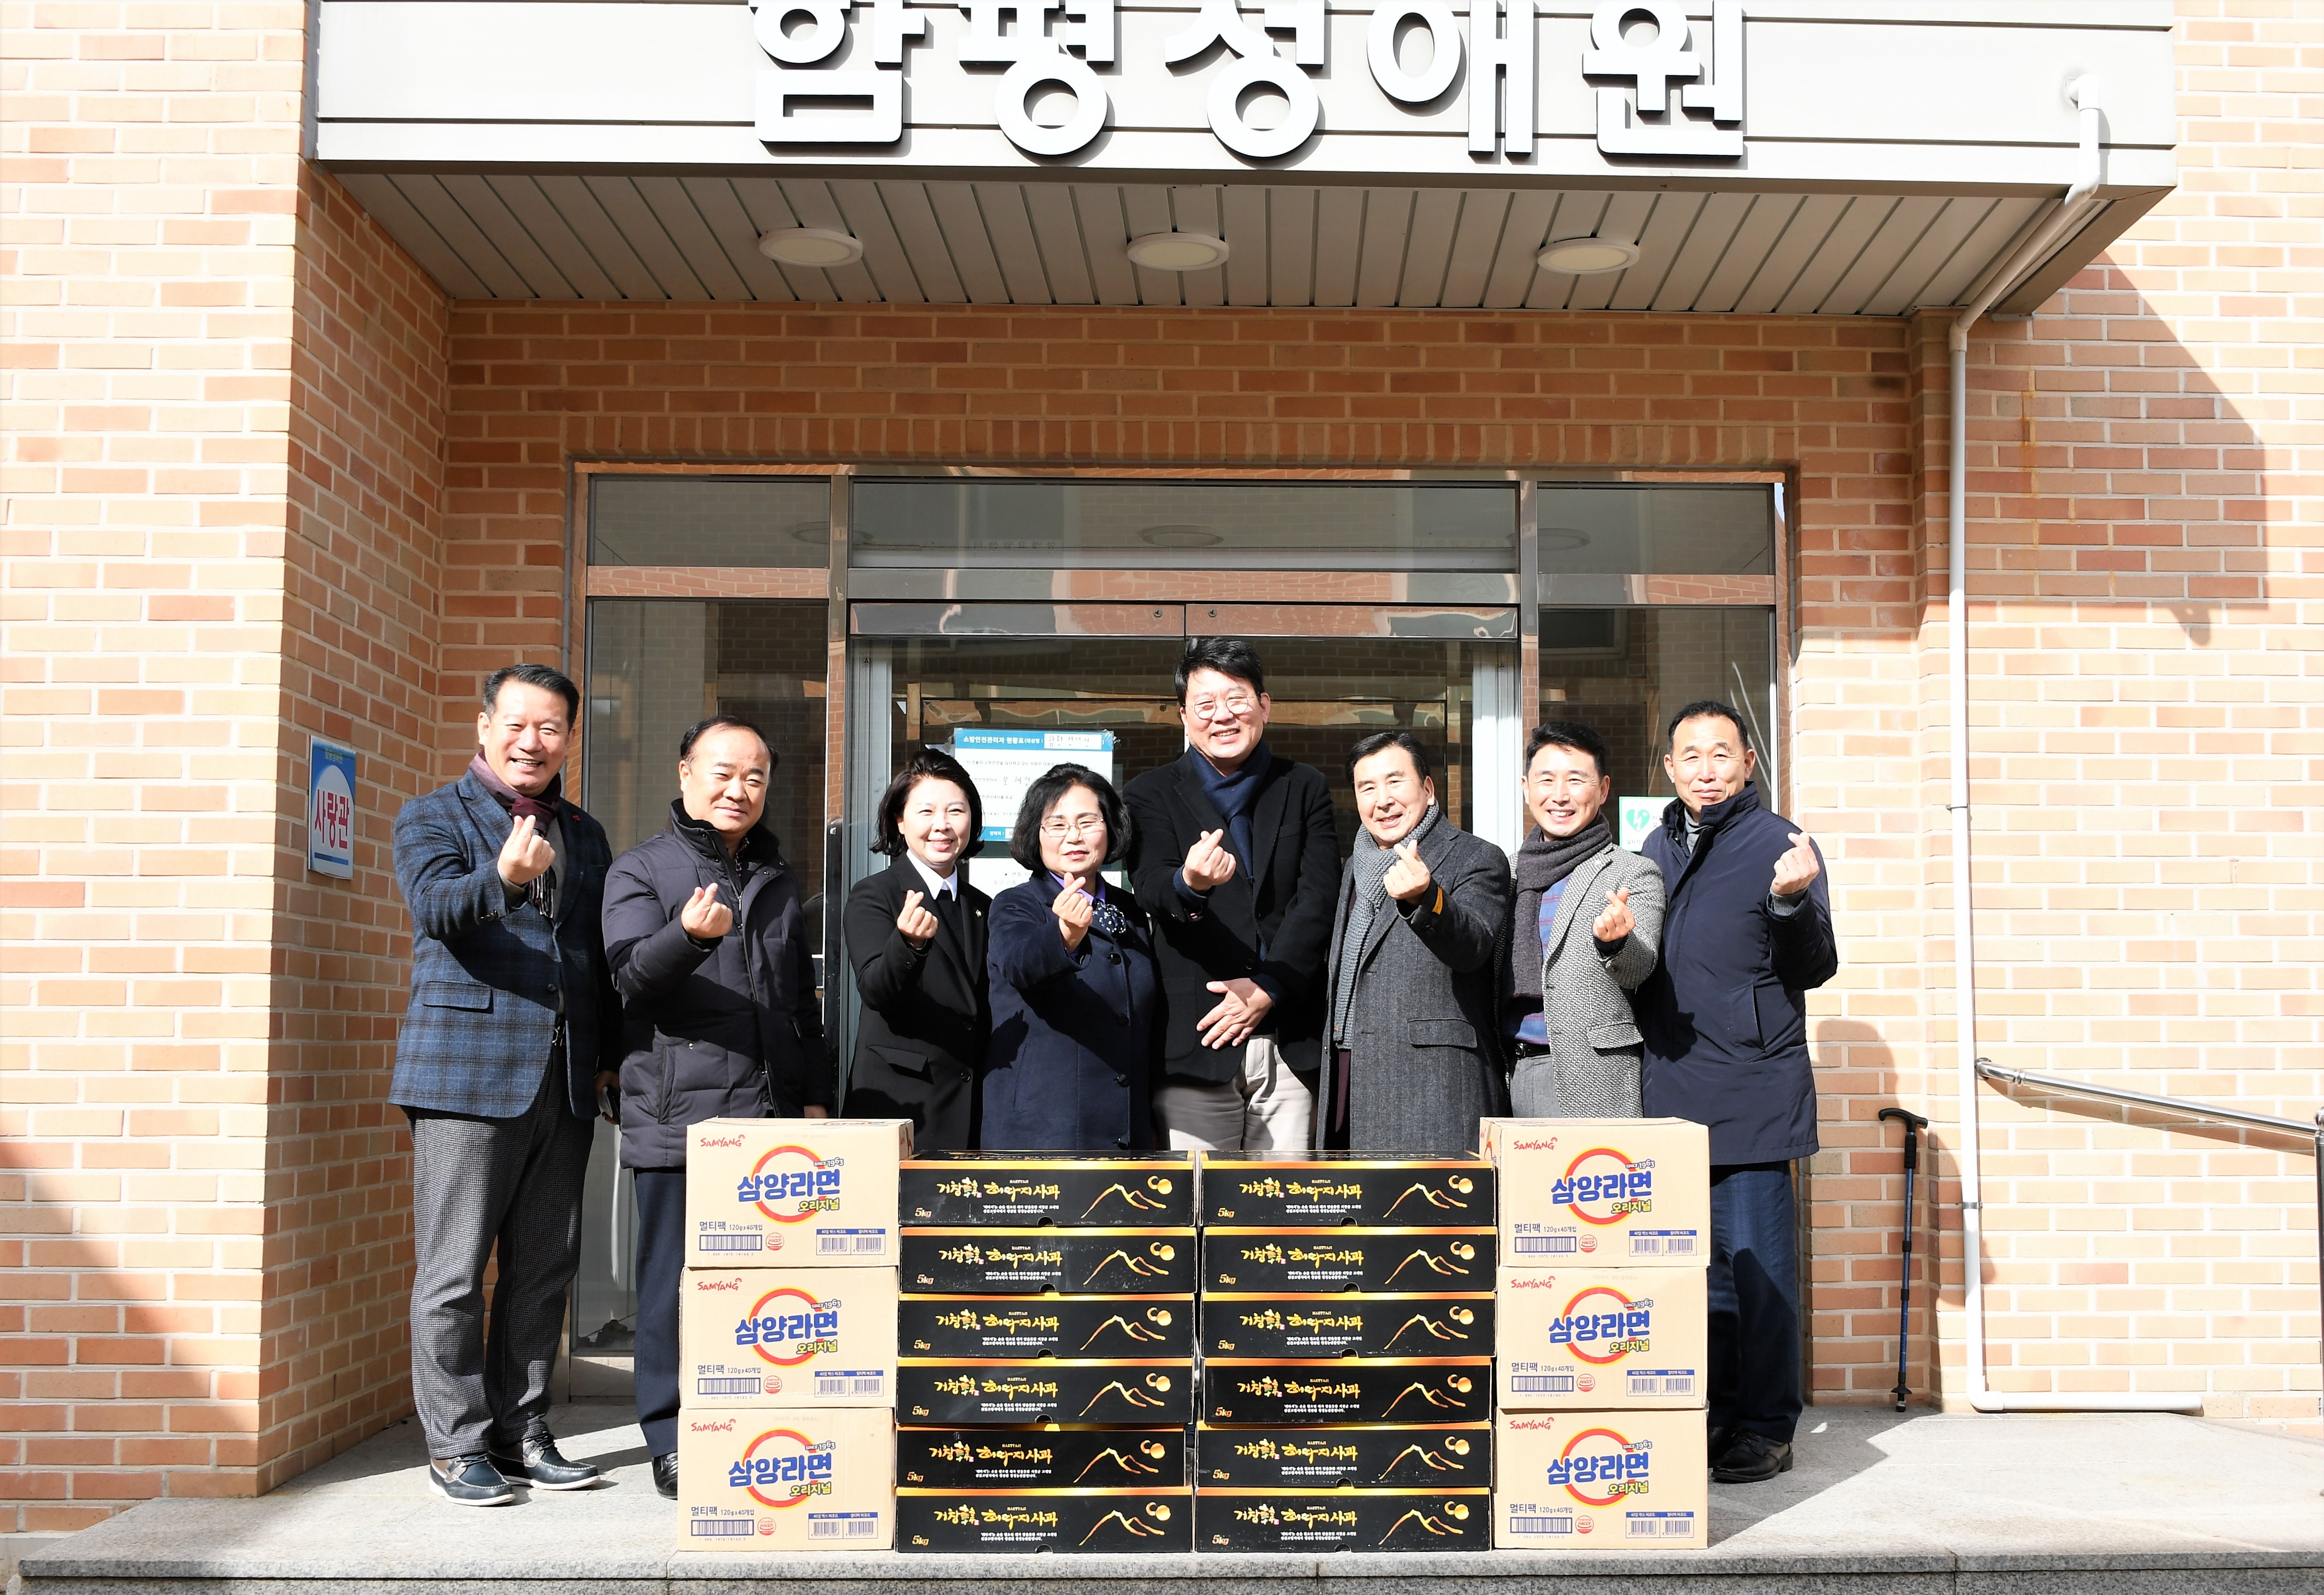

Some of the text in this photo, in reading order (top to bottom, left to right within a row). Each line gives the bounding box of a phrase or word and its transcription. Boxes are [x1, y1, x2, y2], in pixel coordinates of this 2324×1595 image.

[314, 789, 350, 849] 사랑관
[700, 1137, 742, 1147] SAMYANG
[1514, 1140, 1554, 1150] SAMYANG
[827, 1157, 844, 1167] 1963
[1639, 1159, 1655, 1169] 1963
[737, 1169, 840, 1202] 삼양라면
[1551, 1171, 1652, 1204] 삼양라면
[798, 1197, 840, 1212] 오리지널
[1611, 1199, 1652, 1214] 오리지널
[914, 1207, 932, 1218] 5kg
[1218, 1207, 1235, 1218] 5kg
[699, 1221, 726, 1231] 멀티팩
[1514, 1223, 1541, 1233] 멀티팩
[916, 1274, 933, 1285] 5kg
[1219, 1273, 1236, 1284] 5kg
[1511, 1278, 1553, 1289] SAMYANG
[697, 1280, 739, 1291] SAMYANG
[824, 1299, 841, 1309] 1963
[1637, 1299, 1654, 1309] 1963
[735, 1311, 838, 1345] 삼양라면
[1548, 1310, 1650, 1343] 삼양라면
[796, 1340, 837, 1355] 오리지널
[913, 1339, 931, 1350] 5kg
[1218, 1339, 1235, 1350] 5kg
[1609, 1339, 1650, 1353] 오리지널
[697, 1364, 724, 1374] 멀티팩
[1511, 1362, 1538, 1372] 멀티팩
[912, 1405, 929, 1416] 5kg
[1215, 1407, 1232, 1418] 5kg
[691, 1421, 733, 1432] SAMYANG
[1510, 1419, 1551, 1430] SAMYANG
[818, 1441, 835, 1451] 1963
[1636, 1440, 1652, 1450] 1963
[728, 1453, 832, 1487] 삼양라면
[1547, 1452, 1649, 1485] 삼양라면
[907, 1471, 924, 1482] 5kg
[1212, 1469, 1230, 1480] 5kg
[790, 1482, 832, 1497] 오리지널
[1607, 1480, 1649, 1495] 오리지널
[691, 1506, 718, 1516] 멀티팩
[1510, 1503, 1536, 1513] 멀티팩
[911, 1535, 929, 1546] 5kg
[1212, 1534, 1229, 1545] 5kg
